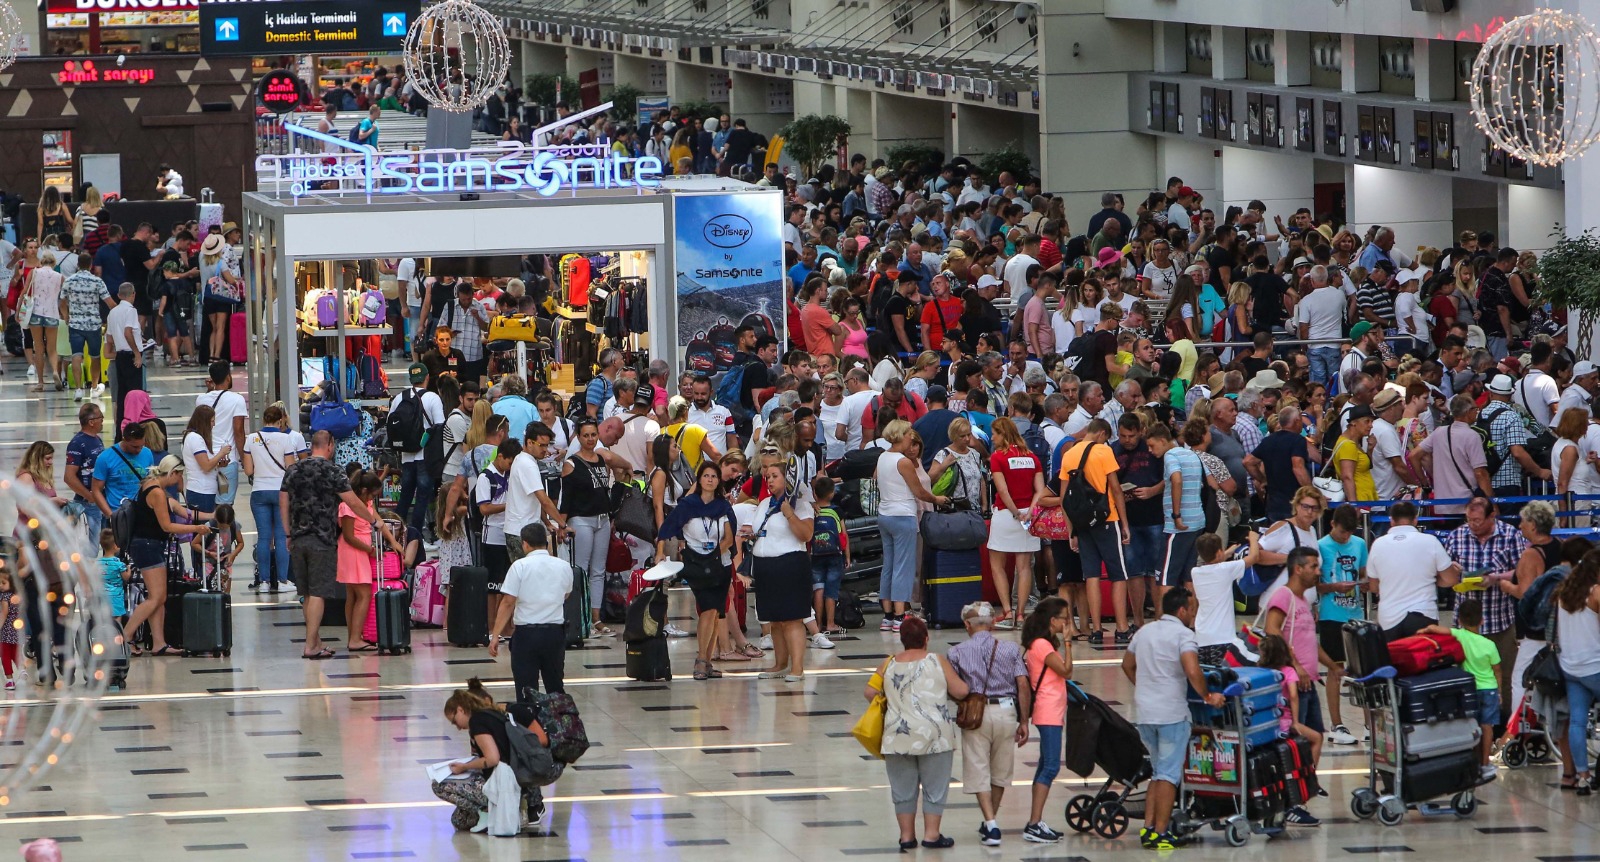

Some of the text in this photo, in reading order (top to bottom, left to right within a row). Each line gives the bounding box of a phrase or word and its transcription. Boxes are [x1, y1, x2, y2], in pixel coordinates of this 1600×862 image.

[265, 11, 357, 28] İç Hatlar Terminali
[265, 28, 357, 42] Domestic Terminal
[58, 60, 98, 82] simit
[267, 77, 295, 92] simit
[289, 159, 357, 178] House
[290, 182, 312, 196] of
[708, 222, 750, 241] Disney
[724, 253, 733, 262] by
[695, 267, 763, 279] Samsonite
[383, 482, 402, 493] Have
[1190, 740, 1235, 764] Have fun!
